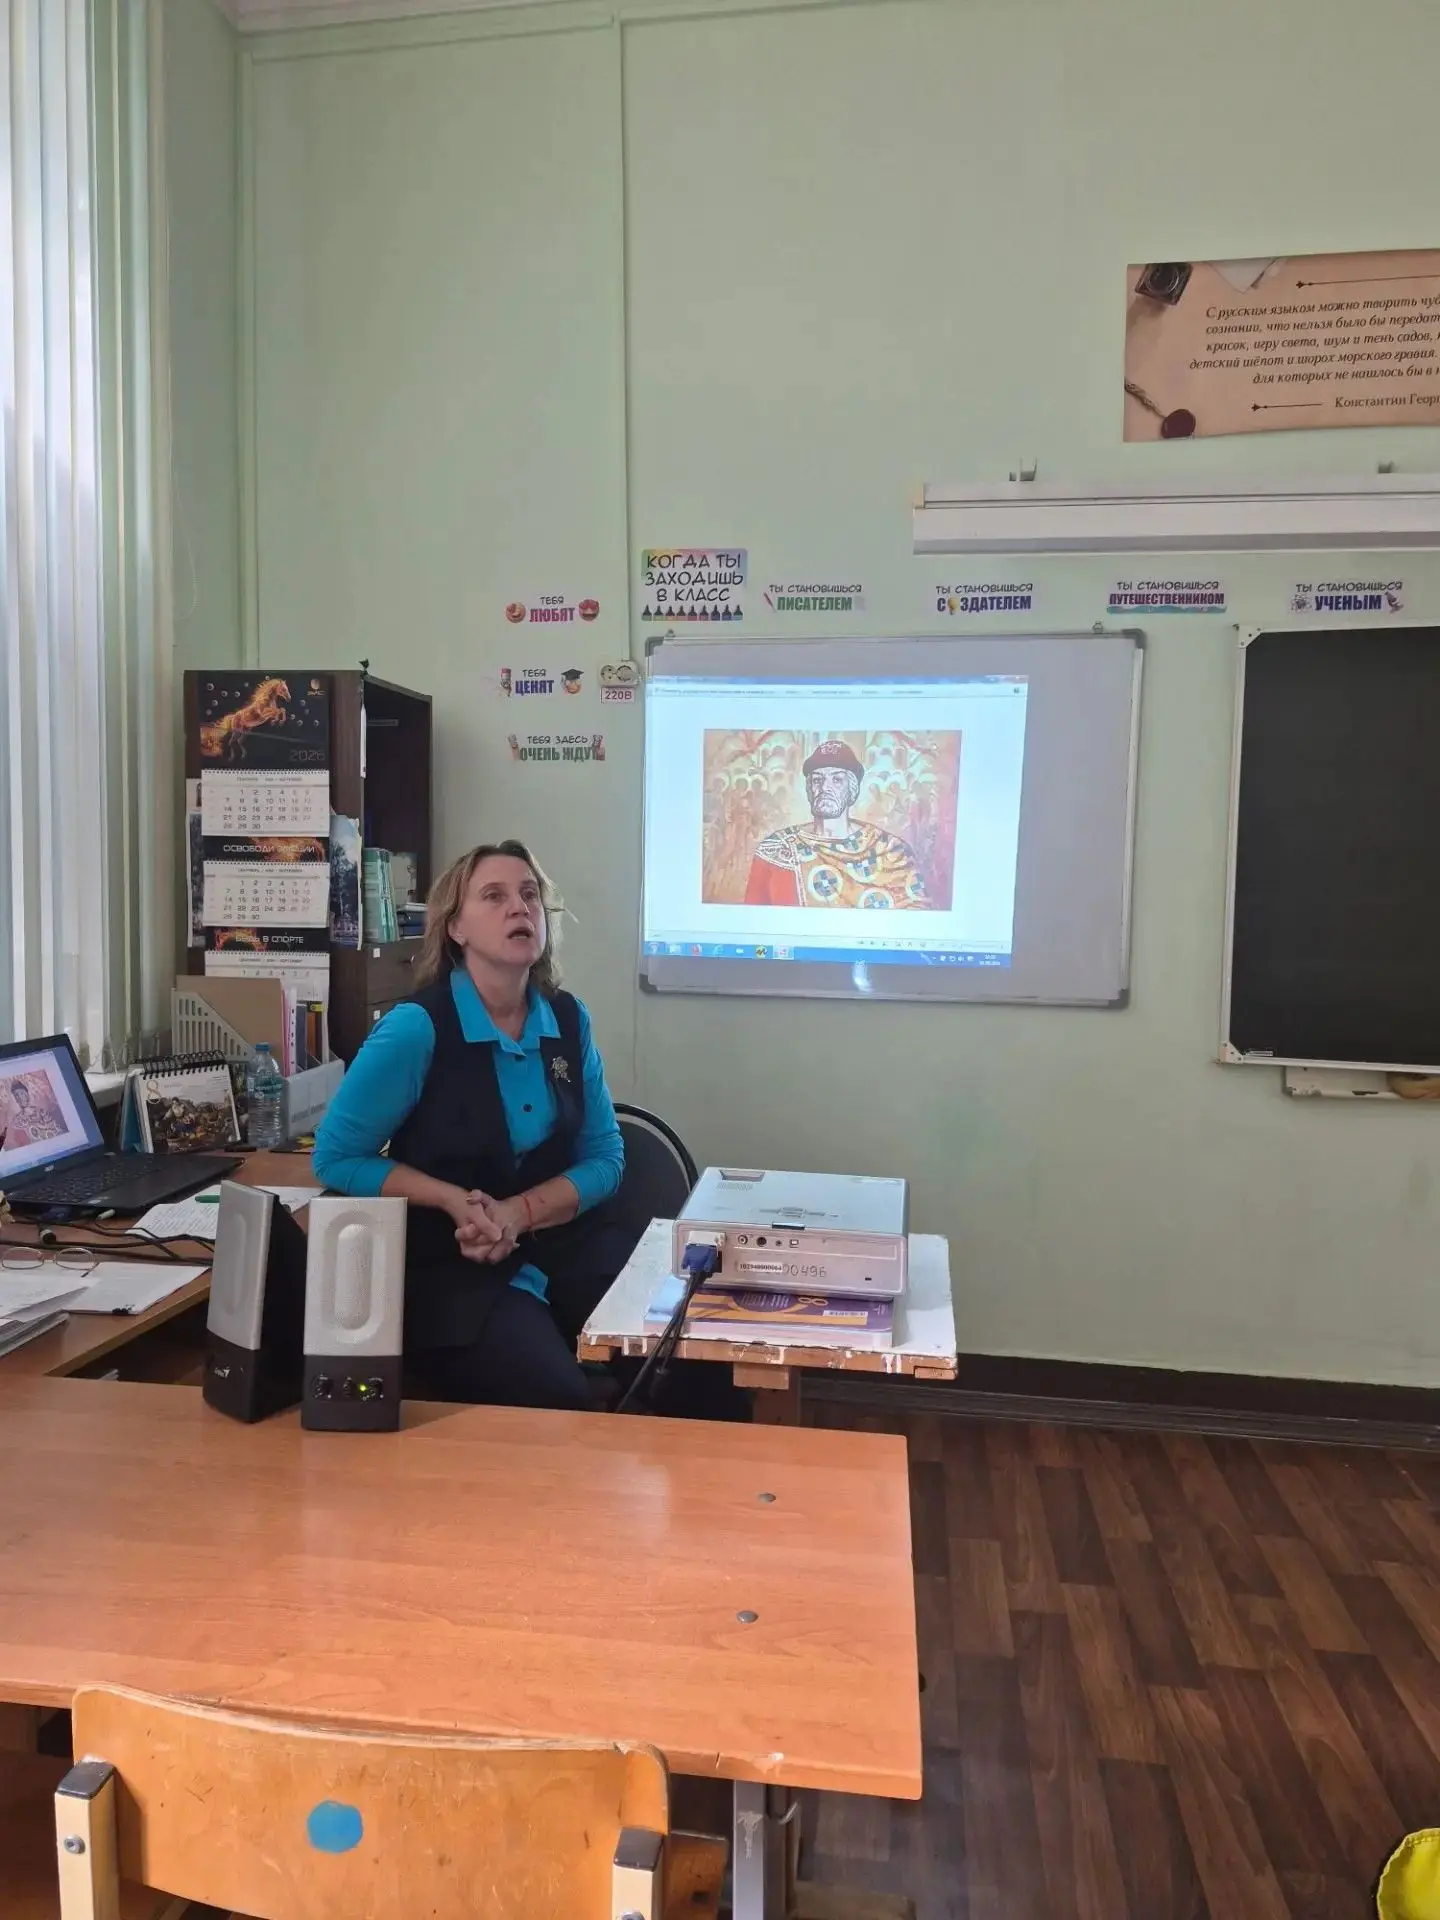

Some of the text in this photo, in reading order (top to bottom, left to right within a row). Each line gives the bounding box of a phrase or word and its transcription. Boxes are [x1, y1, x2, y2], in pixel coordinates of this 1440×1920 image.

[1206, 306, 1217, 318] С
[1218, 307, 1267, 320] русским
[1270, 302, 1316, 315] языком
[1318, 300, 1360, 312] можно
[1362, 298, 1418, 312] творить
[1206, 324, 1262, 335] сознании,
[1267, 322, 1290, 332] что
[1293, 320, 1334, 330] нельзя
[1335, 316, 1366, 328] было
[1369, 314, 1386, 326] бы
[1206, 342, 1250, 356] красок,
[1254, 341, 1279, 355] игру
[1281, 338, 1320, 348] света,
[1324, 336, 1351, 348] шум
[1353, 336, 1361, 344] и
[1364, 334, 1395, 344] тень
[1397, 330, 1433, 342] садов,
[1189, 349, 1438, 370] детский шёпот и шорох морского гравия.
[1252, 373, 1274, 385] для
[1277, 370, 1330, 384] которых
[1334, 370, 1350, 380] не
[1352, 366, 1404, 380] нашлось
[1406, 364, 1424, 376] бы
[1426, 367, 1432, 376] в
[1335, 395, 1407, 408] Константин
[646, 554, 742, 569] КОГДА ТЫ
[645, 572, 744, 586] ЗАХОДИШЬ
[1117, 581, 1219, 590] ТЫ СТАНОВИШЬСЯ
[769, 584, 862, 594] ТЫ СТАНОВИШЬСЯ
[936, 583, 1033, 594] ТЫ СТАНОВИШЬСЯ
[1296, 581, 1402, 592] ТЫ СТАНОВИШЬСЯ
[540, 596, 564, 605] ТЕБЯ
[656, 588, 730, 602] В КЛАСС
[1109, 592, 1224, 605] ПУТЕШЕСТВЕННИКОМ
[777, 596, 853, 611] ПИСАТЕЛЕМ
[1314, 594, 1382, 611] УЧЕНЫМ
[529, 607, 576, 622] ЛЮБЯТ
[522, 669, 546, 678] ТЕБЯ
[515, 680, 554, 694] ЦЕНЯТ
[527, 735, 588, 744] ТЕБЯ ЗДЕСЬ
[520, 746, 560, 761] ОЧЕНЬ
[223, 844, 274, 853] ОСВОБОДИ
[272, 936, 304, 944] СПОРТЕ
